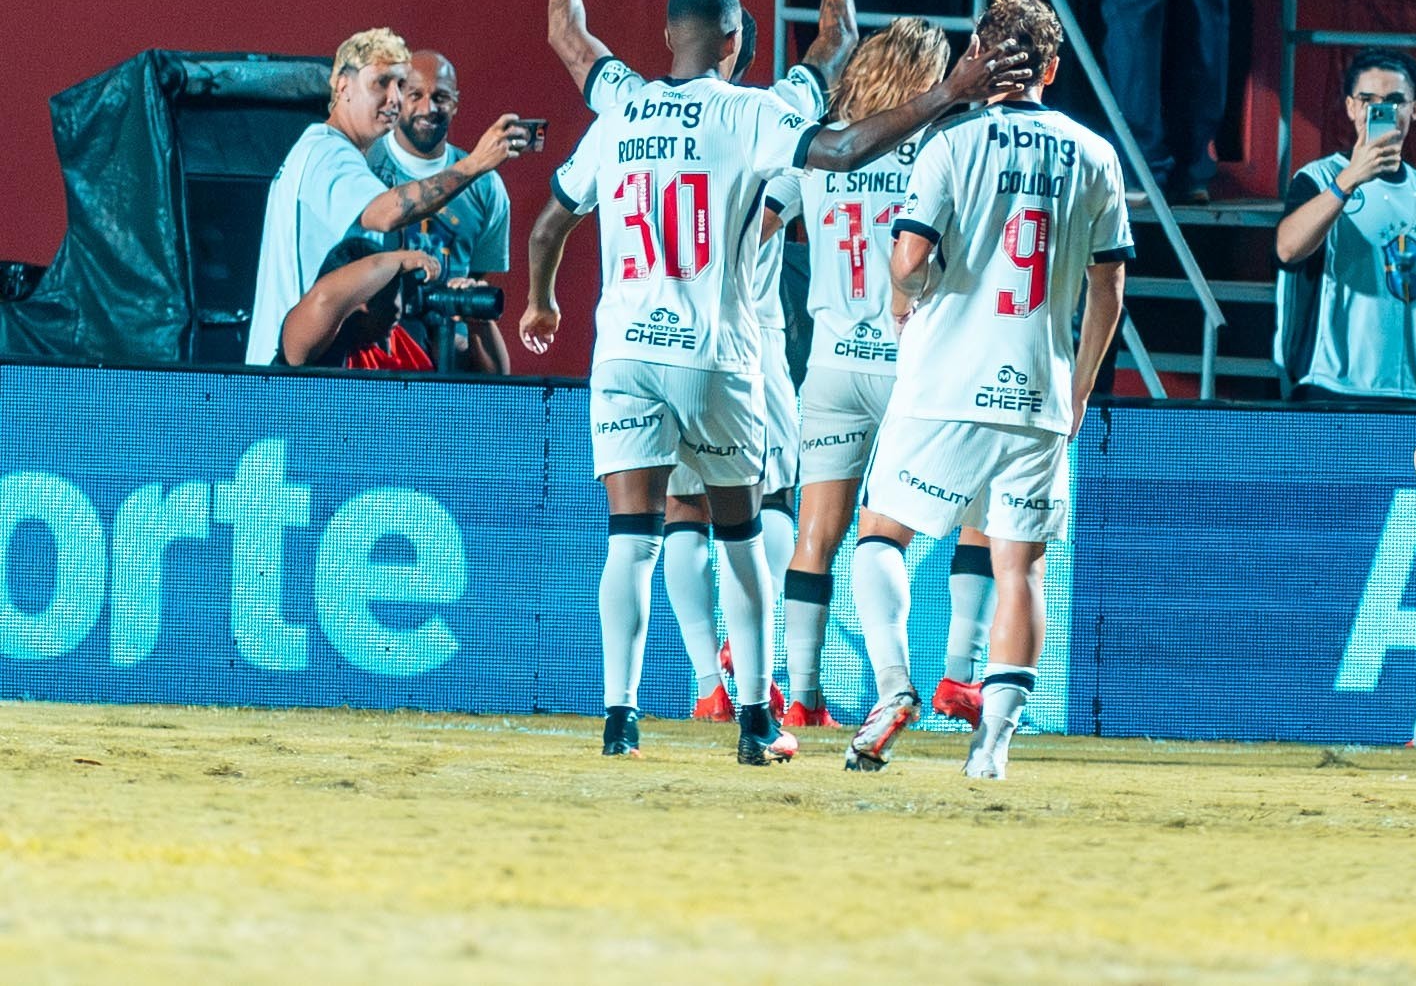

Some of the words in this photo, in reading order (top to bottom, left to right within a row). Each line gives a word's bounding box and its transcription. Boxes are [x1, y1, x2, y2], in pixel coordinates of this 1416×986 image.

[641, 99, 702, 129] bmg
[618, 136, 677, 164] ROBERT
[685, 136, 702, 161] R.
[1013, 124, 1075, 167] bmg
[826, 172, 839, 193] C.
[612, 169, 713, 282] 30
[994, 207, 1049, 319] 9
[625, 328, 697, 350] CHEFE
[647, 323, 678, 333] MOTO
[834, 342, 898, 362] CHEFE
[975, 393, 1043, 412] CHEFE
[601, 413, 664, 434] FACILITY
[808, 430, 868, 451] FACILITY
[910, 477, 973, 507] FACILITY
[0, 437, 467, 677] orte
